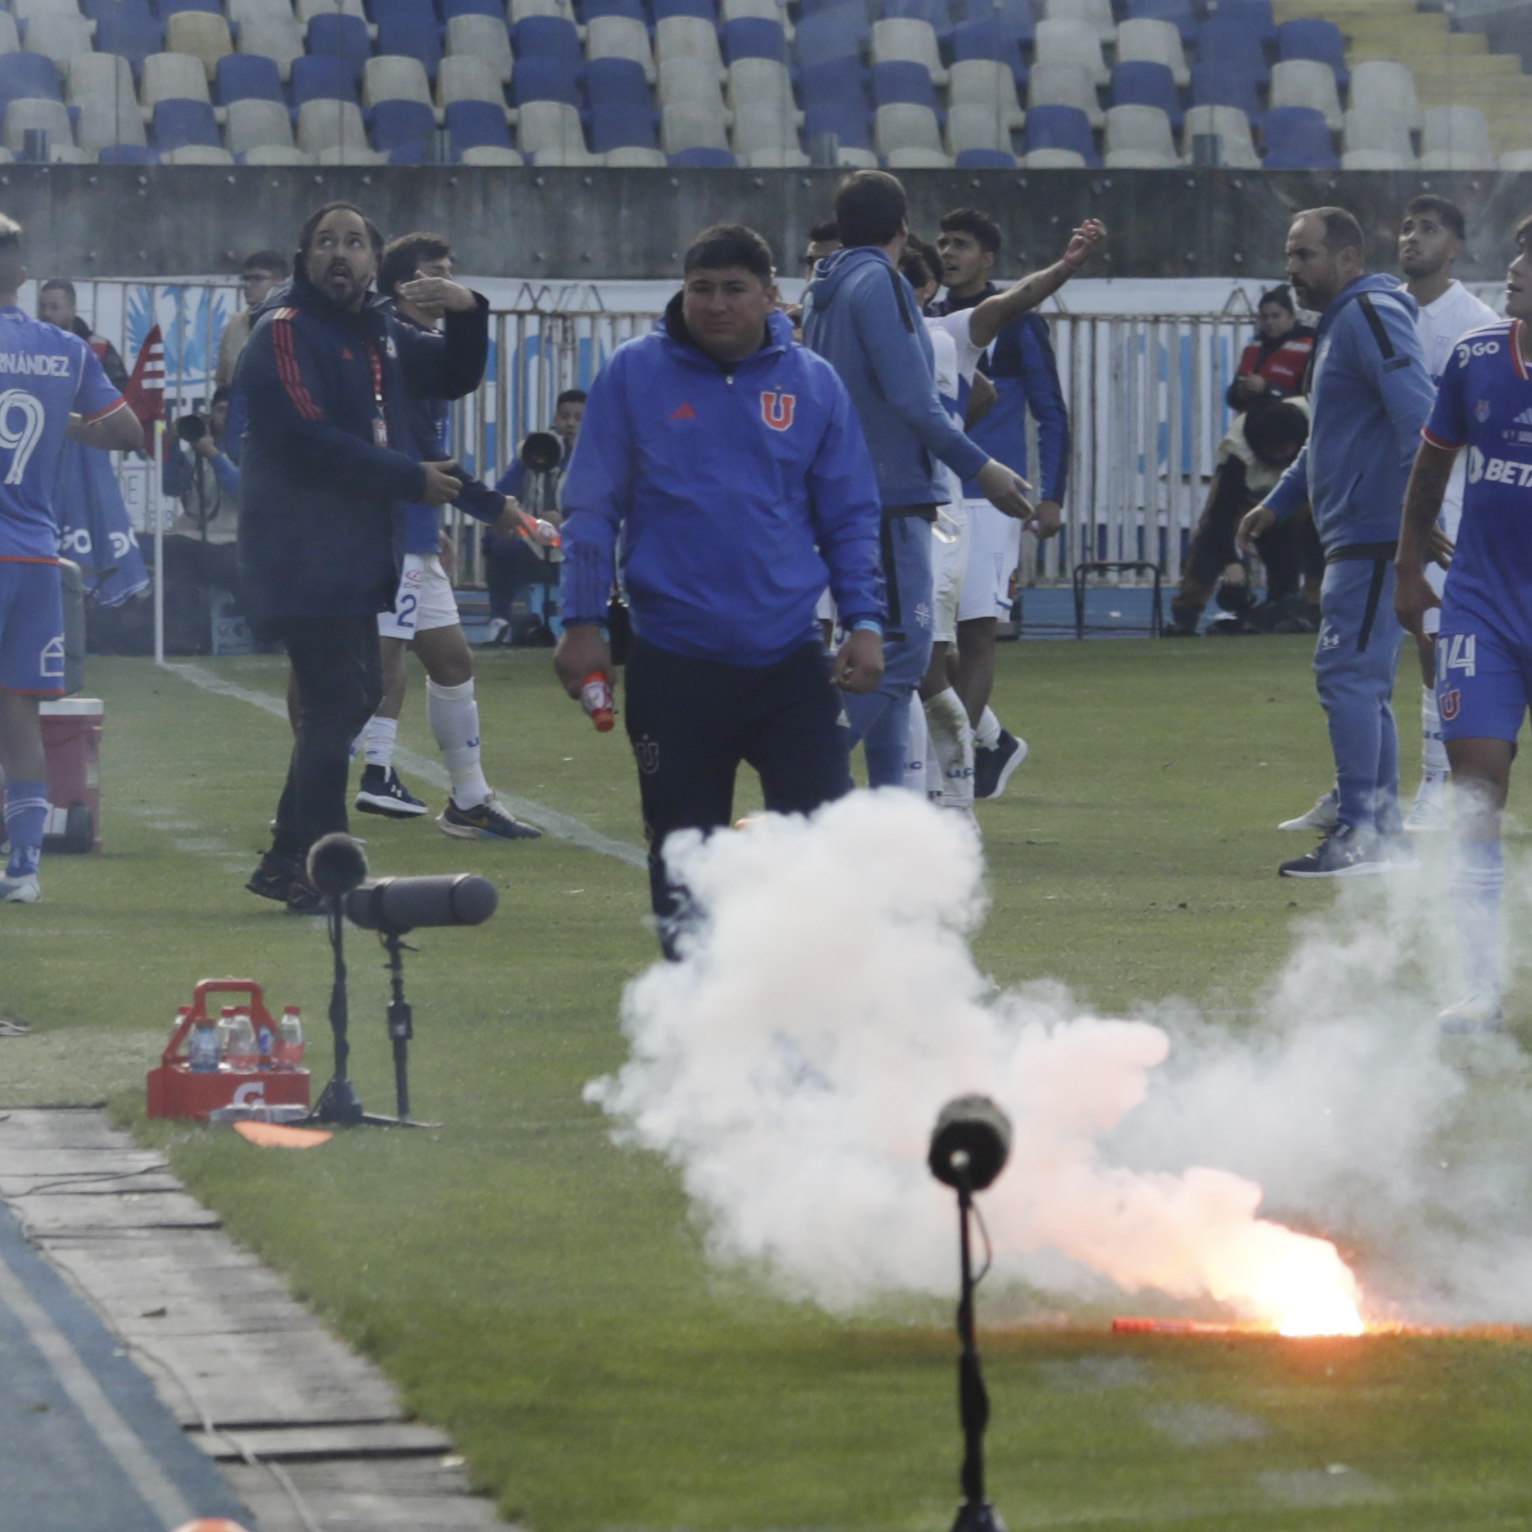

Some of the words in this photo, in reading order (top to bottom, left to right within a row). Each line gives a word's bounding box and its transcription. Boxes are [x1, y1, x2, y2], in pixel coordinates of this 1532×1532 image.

[760, 391, 796, 432] U
[397, 594, 417, 628] 2
[1439, 634, 1476, 681] 14
[1440, 689, 1460, 721] U
